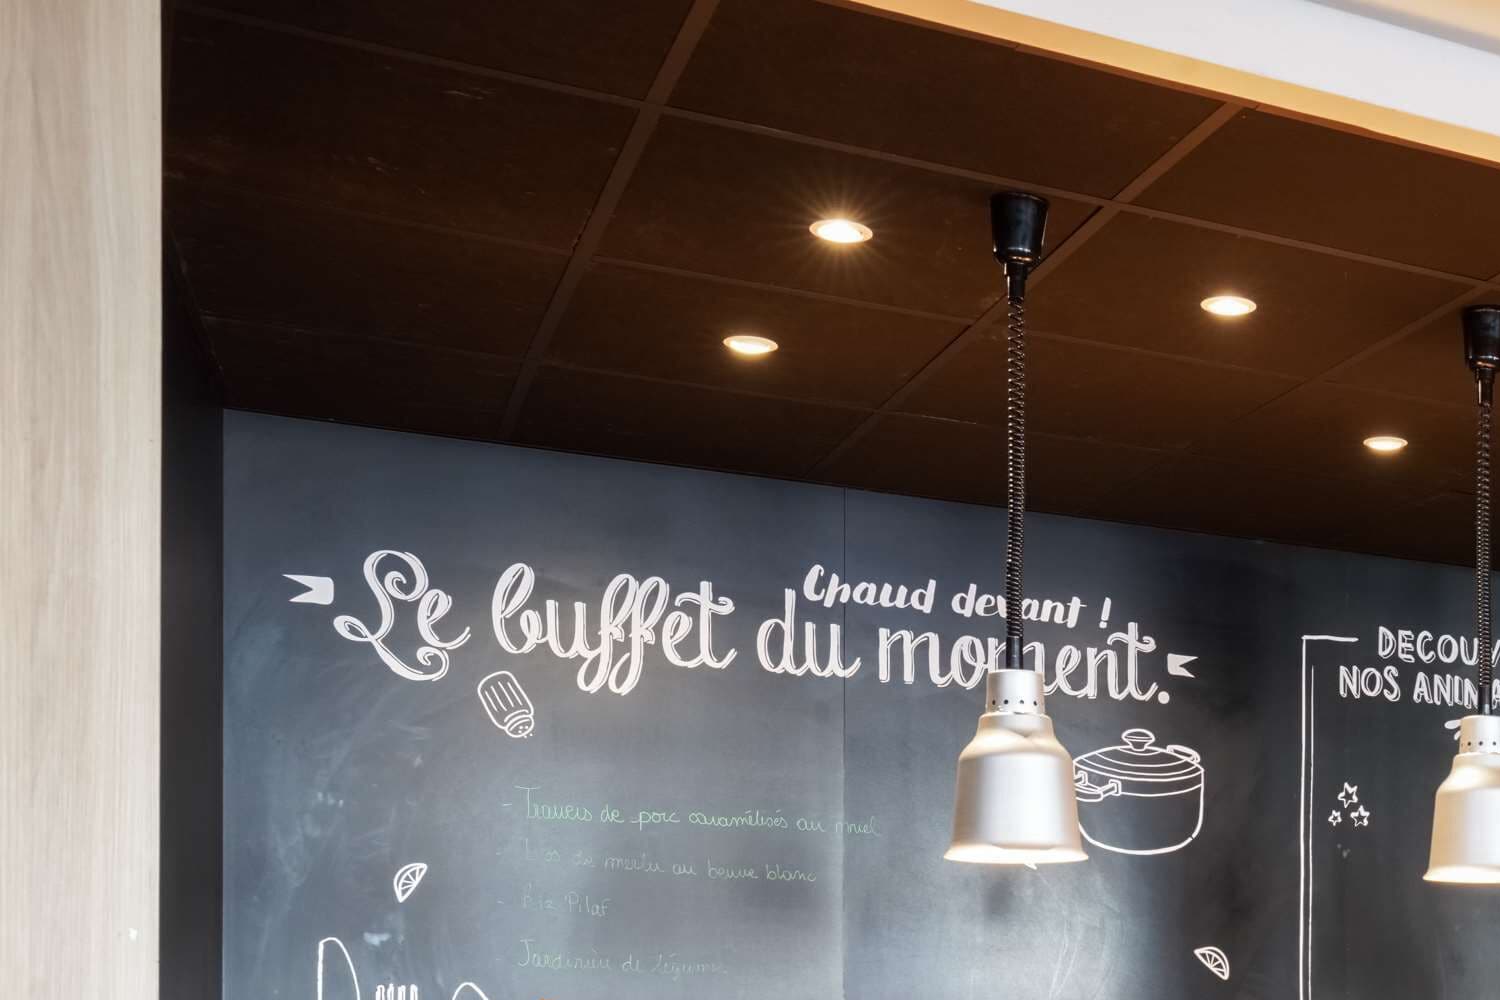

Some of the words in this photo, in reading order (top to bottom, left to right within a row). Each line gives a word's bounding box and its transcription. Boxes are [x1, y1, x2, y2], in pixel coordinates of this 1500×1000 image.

[803, 564, 936, 614] Chaud
[1099, 597, 1111, 629] !
[333, 549, 471, 682] Le
[491, 562, 737, 696] buffet
[756, 588, 861, 678] du
[1339, 665, 1401, 702] NOS
[600, 804, 625, 824] de
